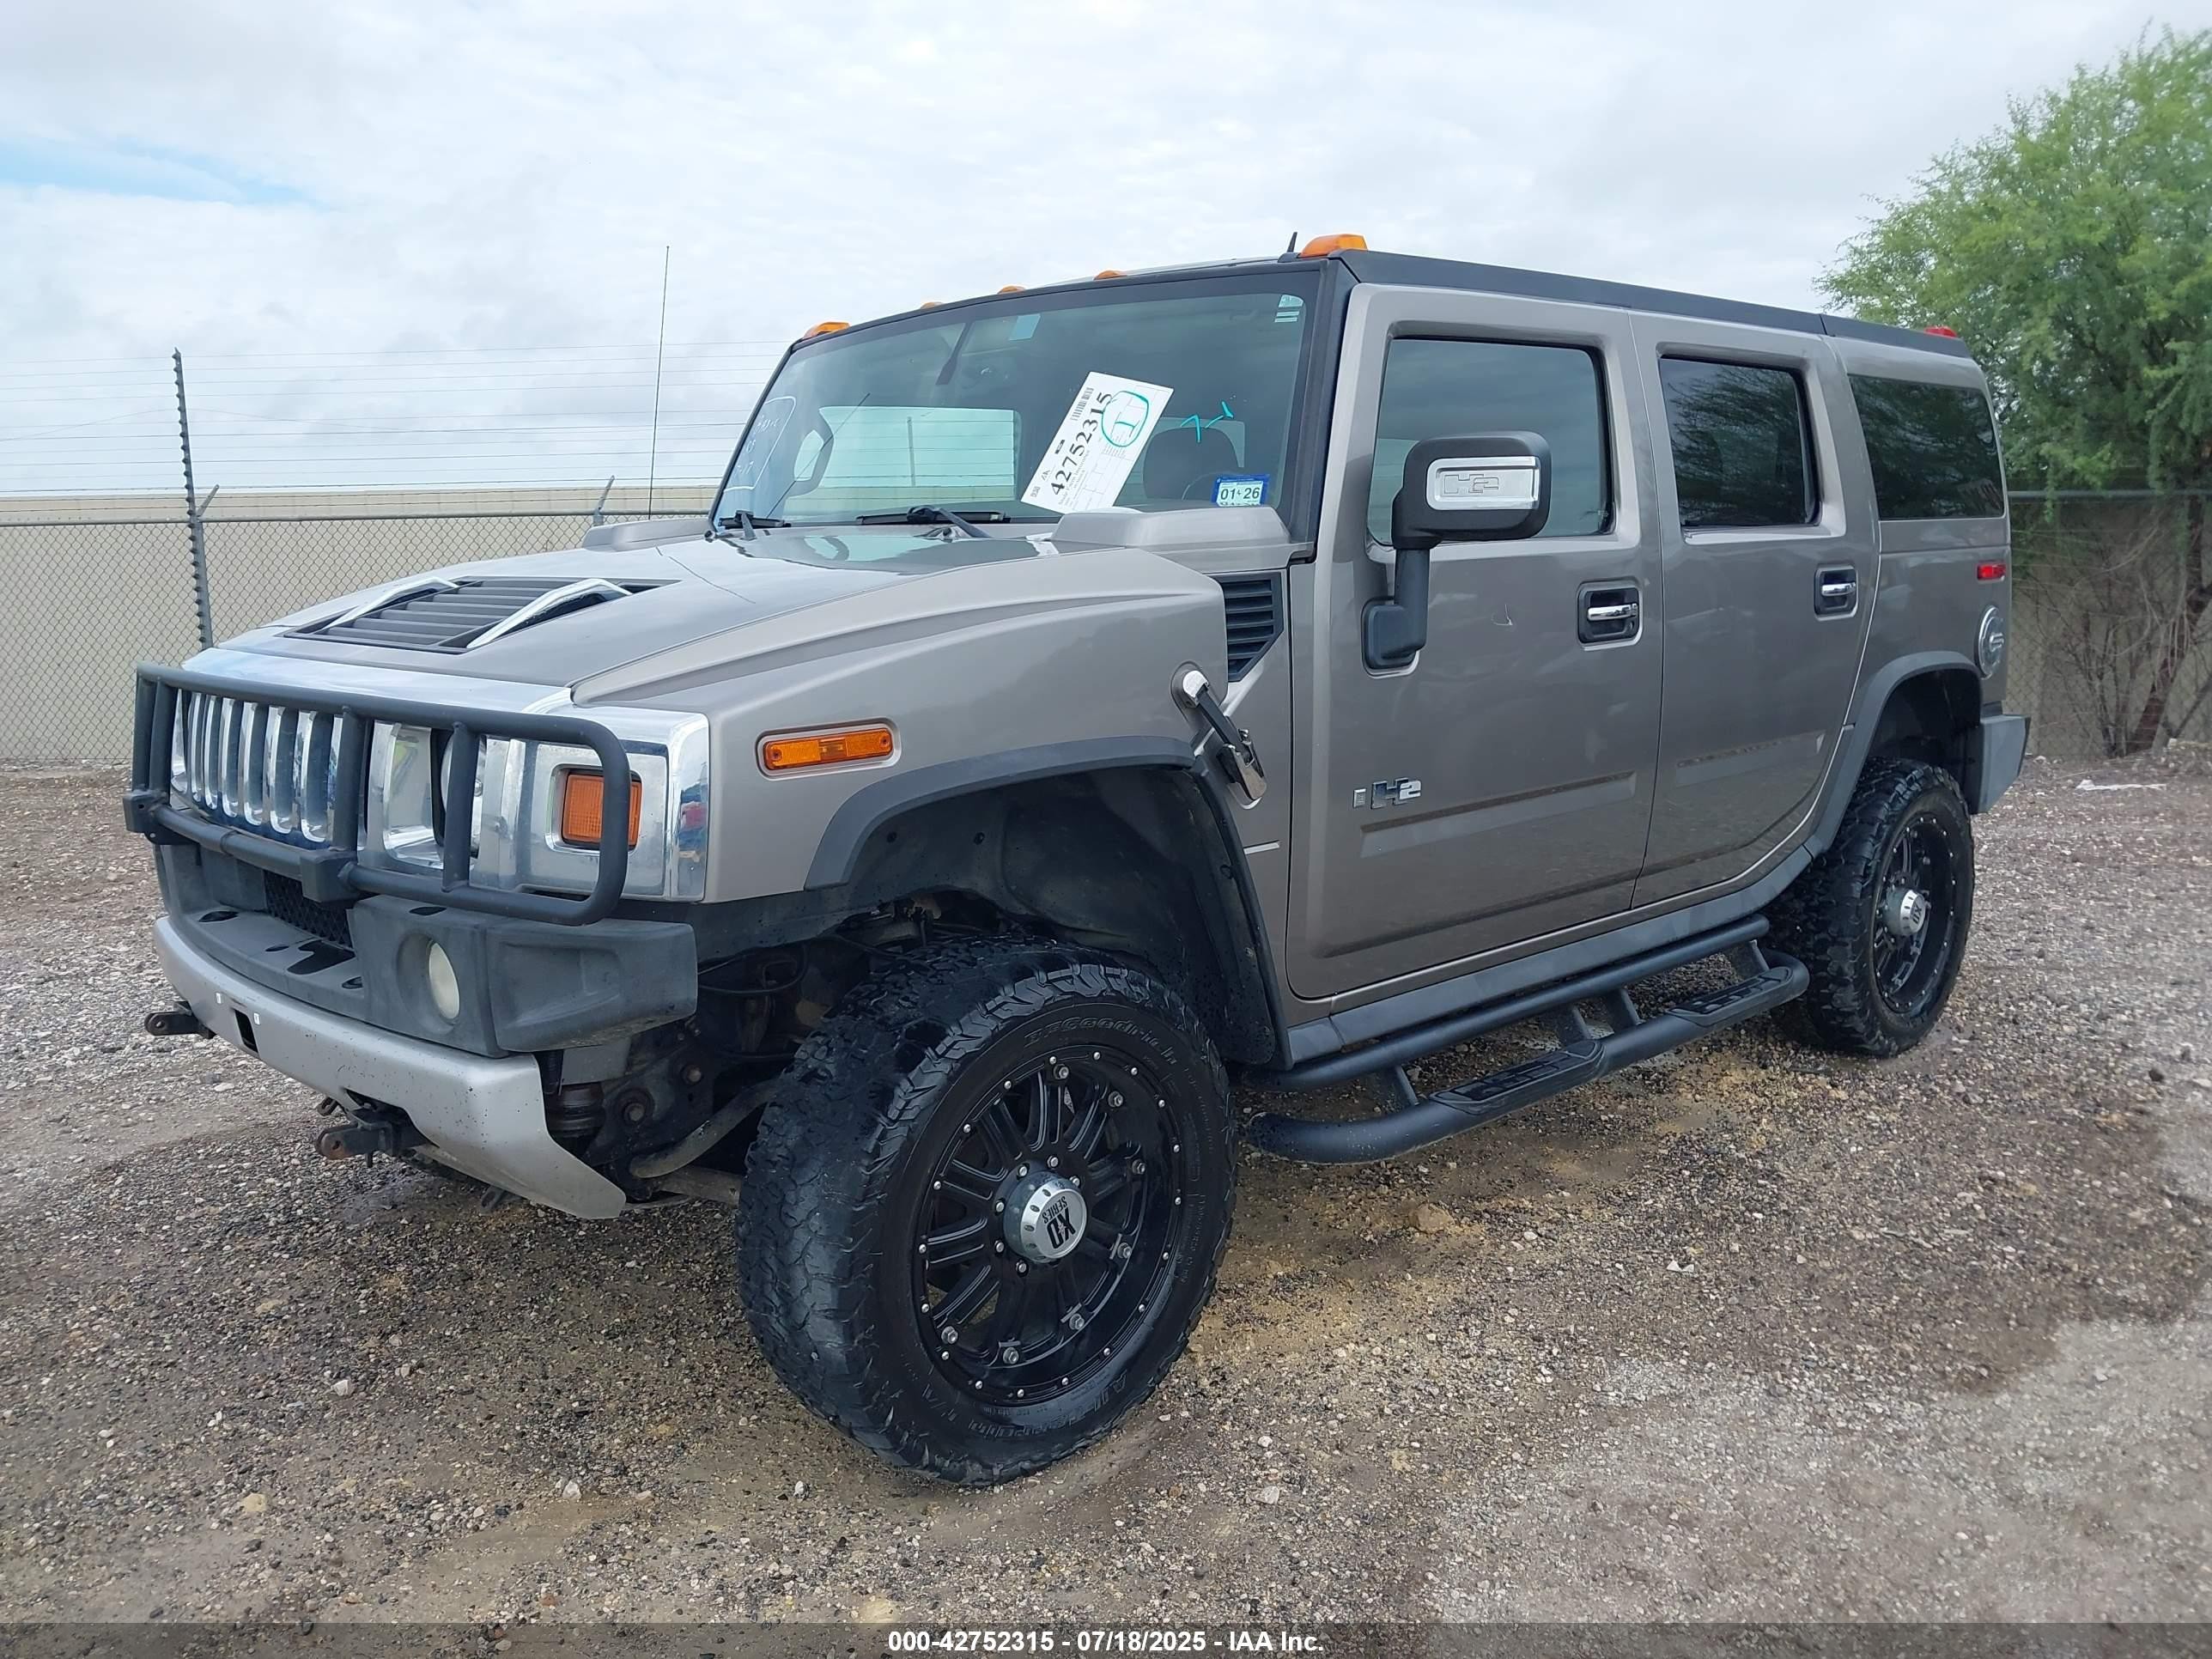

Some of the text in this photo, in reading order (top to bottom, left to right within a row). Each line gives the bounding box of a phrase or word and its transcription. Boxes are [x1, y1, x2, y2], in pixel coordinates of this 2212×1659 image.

[1050, 392, 1113, 495] 42752315
[1220, 487, 1261, 500] 01 26
[1443, 473, 1499, 494] H2
[1042, 1195, 1069, 1224] SERIES
